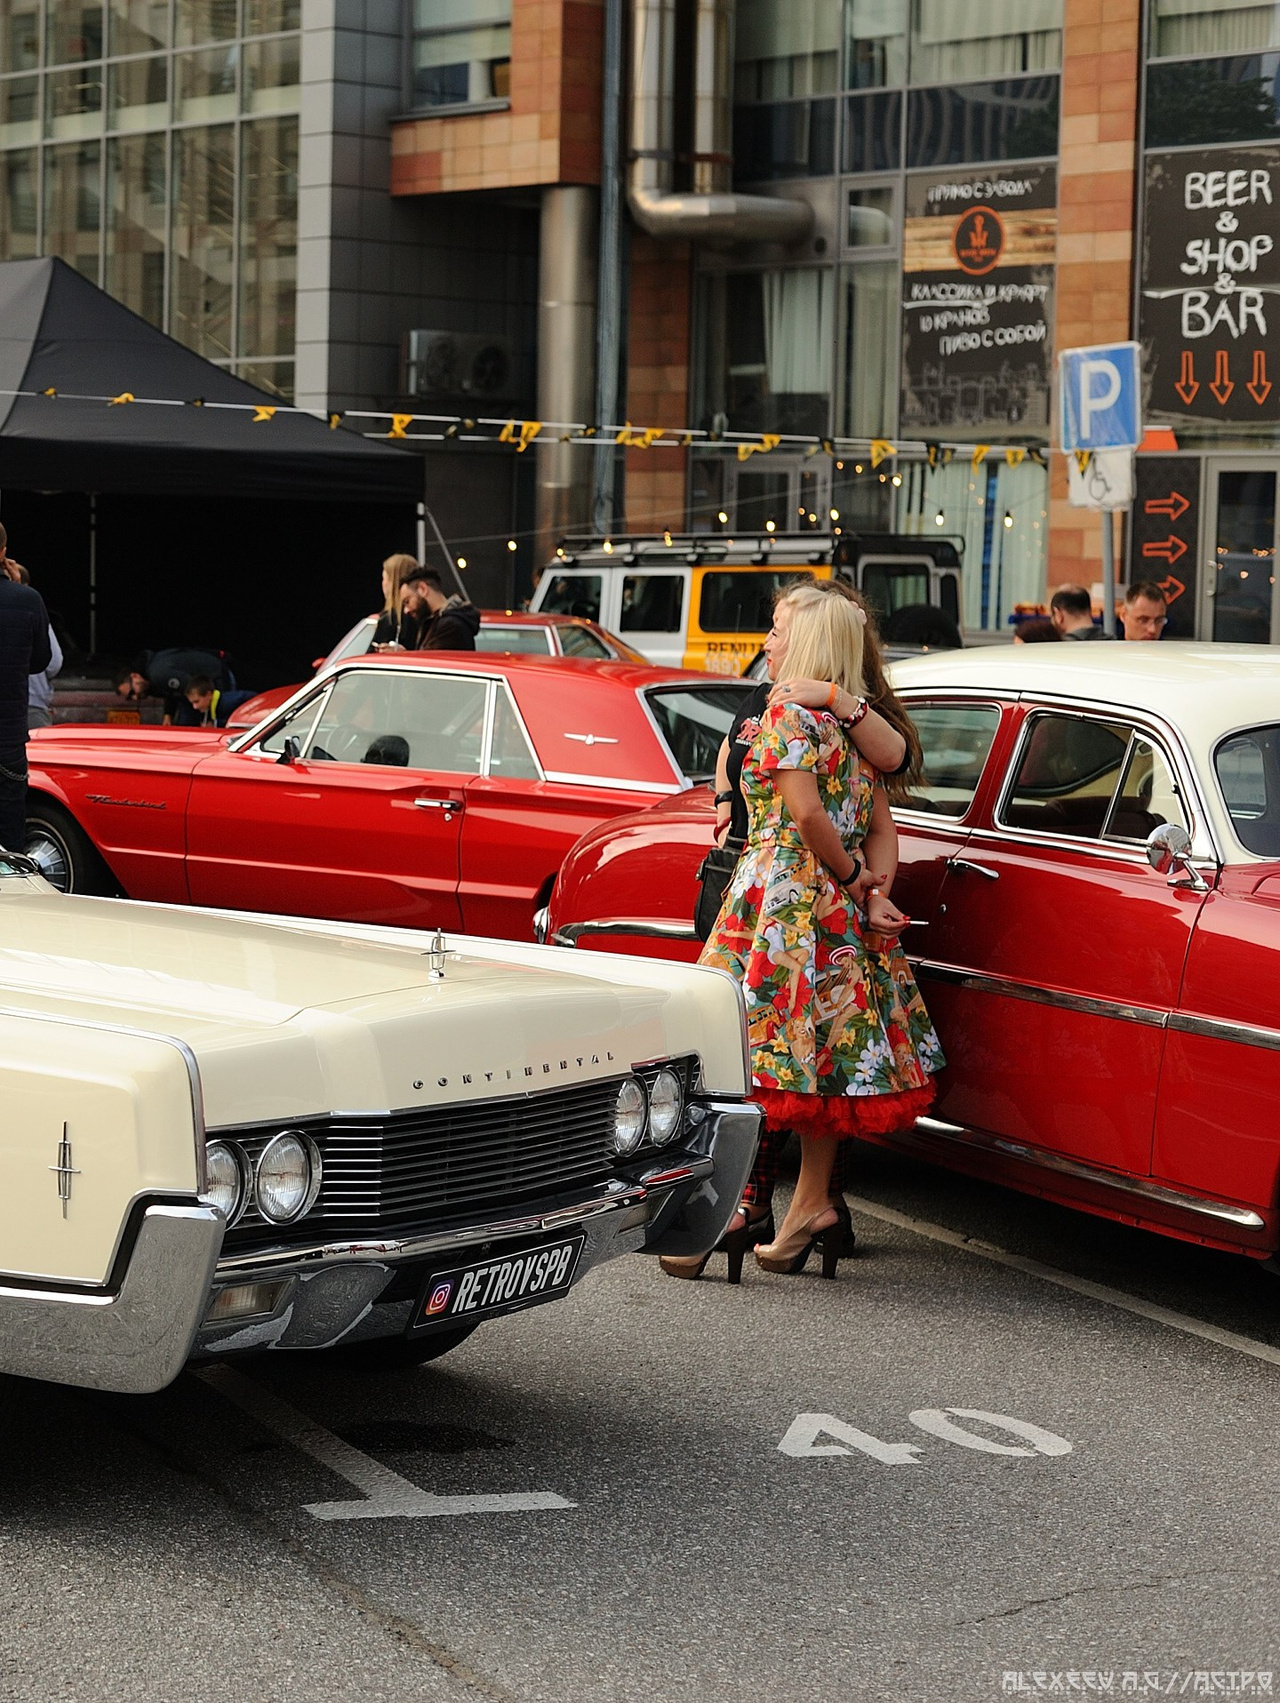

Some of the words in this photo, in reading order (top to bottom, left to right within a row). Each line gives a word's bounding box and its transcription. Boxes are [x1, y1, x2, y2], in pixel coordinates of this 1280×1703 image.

[927, 183, 973, 203] ПРЯМО
[1185, 169, 1272, 210] BEER
[1215, 211, 1239, 233] &
[1180, 234, 1273, 275] SHOP
[911, 282, 983, 301] КЛАССИКА
[985, 284, 996, 299] И
[998, 283, 1049, 303] КРАФТ
[1213, 272, 1236, 294] &
[933, 307, 991, 331] КРАНОВ
[1182, 290, 1267, 340] BAR
[939, 331, 981, 356] ПИВО
[981, 329, 995, 348] С
[994, 319, 1046, 346] СОБОЙ
[1080, 358, 1122, 441] P
[412, 1051, 614, 1090] CONTINENTAL
[451, 1244, 573, 1314] RETROVSPB
[776, 1407, 1073, 1465] 40
